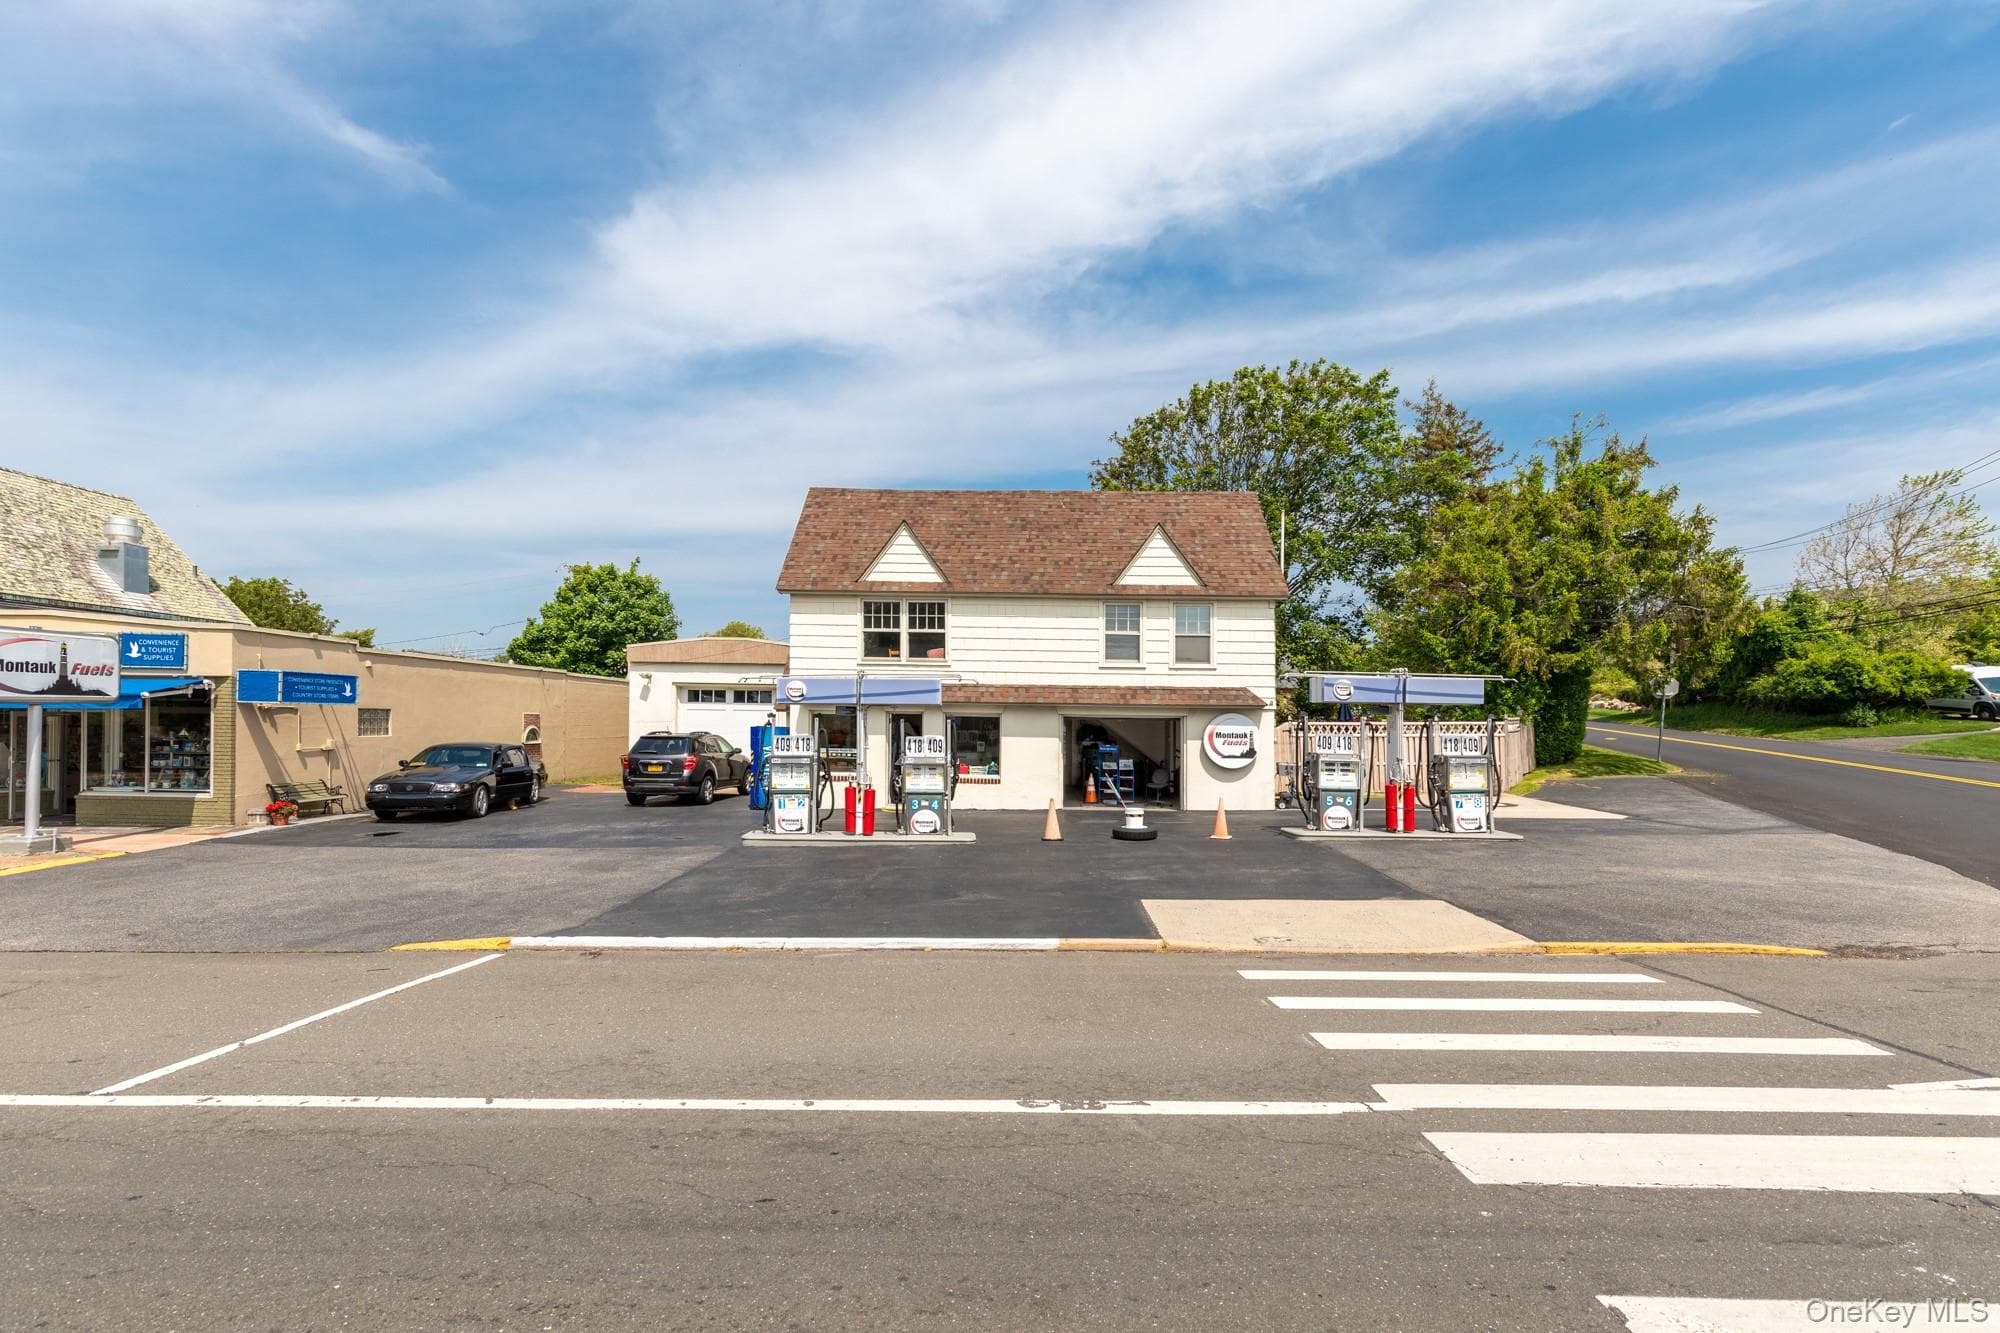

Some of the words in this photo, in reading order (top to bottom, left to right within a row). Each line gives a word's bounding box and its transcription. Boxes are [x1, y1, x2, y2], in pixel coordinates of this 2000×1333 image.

[70, 662, 114, 676] Fuels
[775, 737, 790, 752] 409
[795, 737, 810, 752] 418
[907, 738, 922, 753] 418
[928, 738, 942, 753] 409
[1317, 736, 1332, 750] 409
[1336, 736, 1352, 750] 418
[1444, 738, 1458, 752] 418
[1464, 738, 1478, 752] 409
[798, 799, 805, 808] 2
[912, 800, 918, 810] 3
[932, 800, 938, 810] 4
[1326, 796, 1334, 806] 5
[1346, 796, 1352, 806] 6
